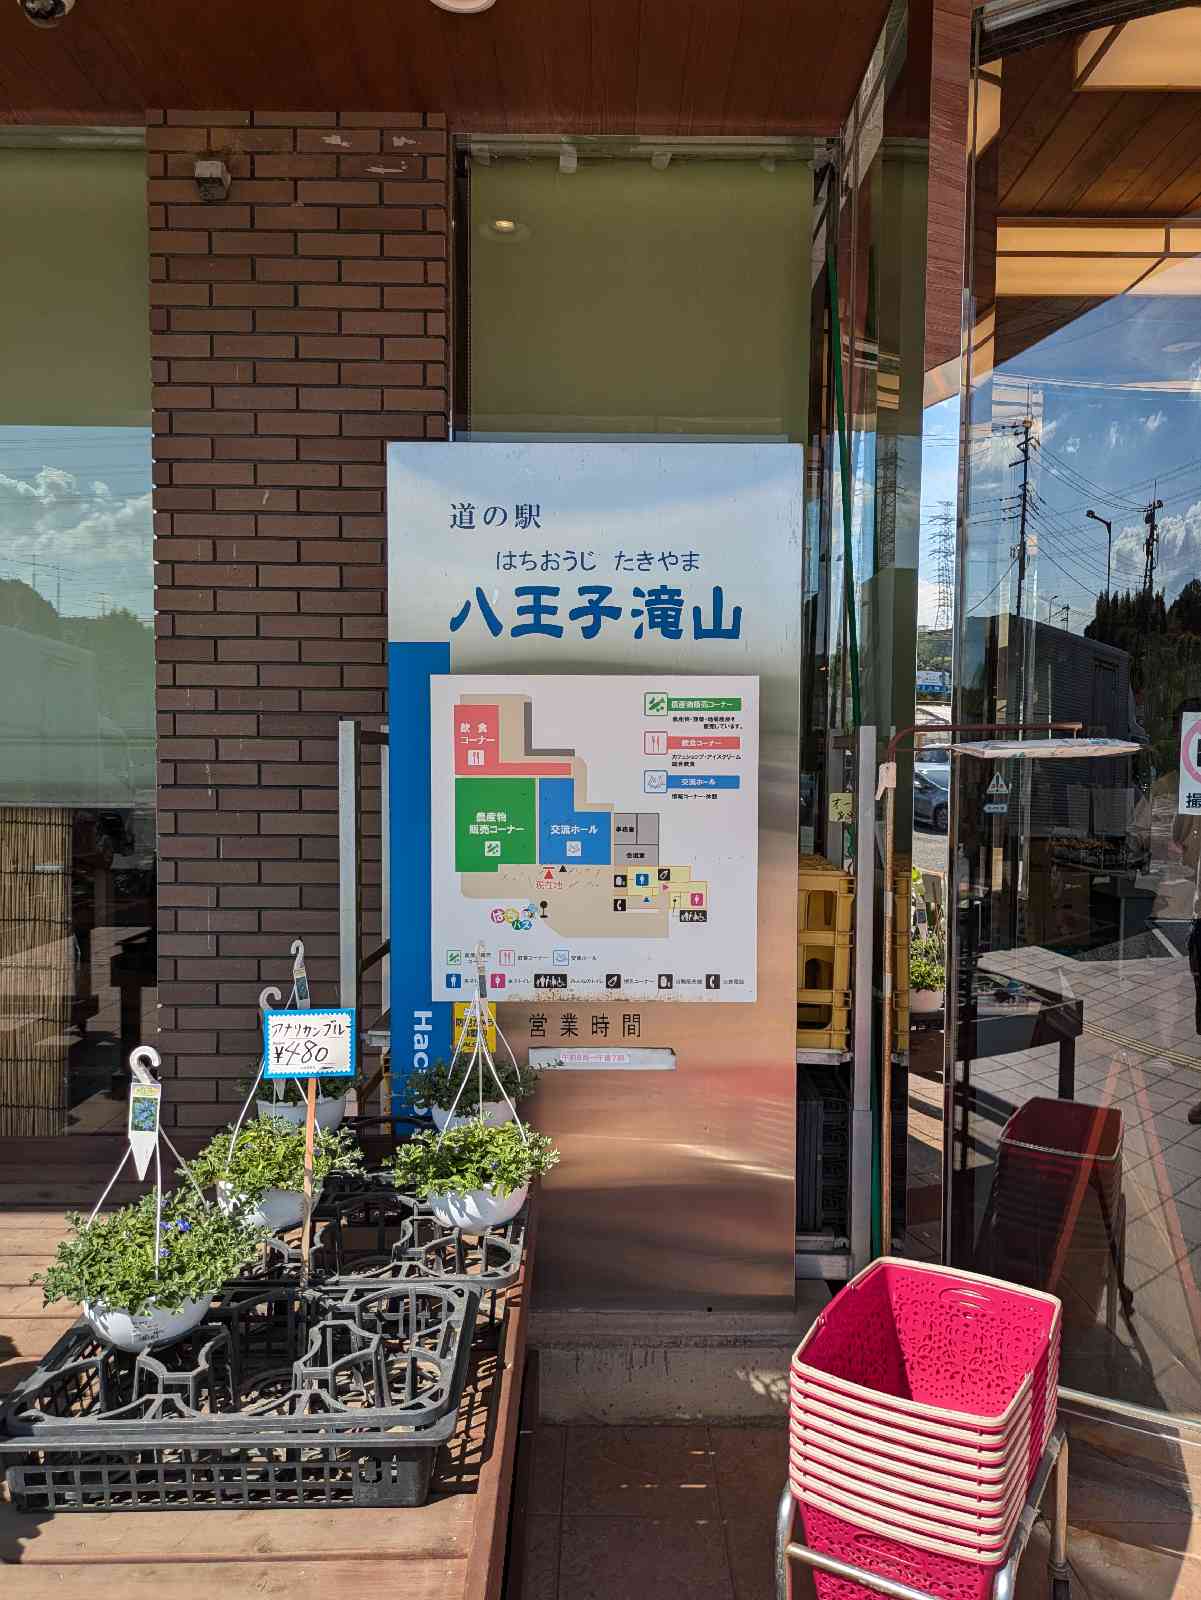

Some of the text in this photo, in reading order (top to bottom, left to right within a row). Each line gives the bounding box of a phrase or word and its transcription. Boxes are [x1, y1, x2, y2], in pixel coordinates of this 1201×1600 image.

[449, 503, 541, 530] 道の駅
[496, 550, 700, 572] はちおうじ たきやま
[450, 585, 742, 640] 八王子滝山
[460, 735, 496, 744] コーナー
[469, 824, 525, 835] 販売コーナー
[550, 824, 599, 835] 交流ホール
[528, 1013, 641, 1038] 営業時間
